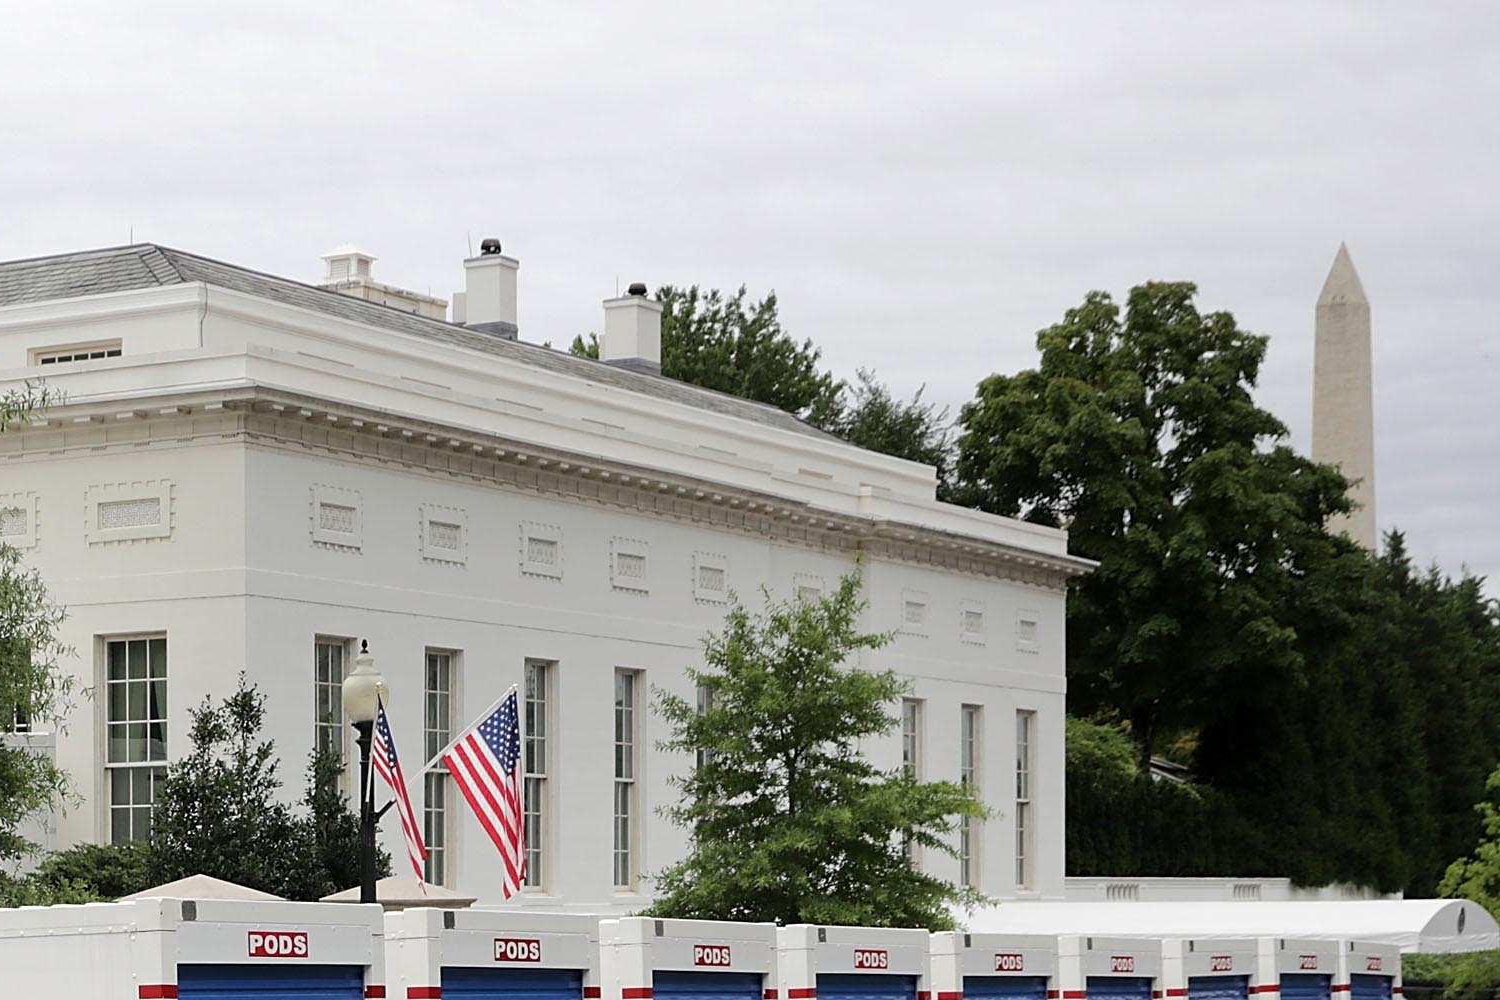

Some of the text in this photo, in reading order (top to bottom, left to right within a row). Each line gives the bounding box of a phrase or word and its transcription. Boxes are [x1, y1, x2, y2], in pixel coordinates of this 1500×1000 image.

[249, 934, 307, 955] PODS
[495, 941, 540, 960] PODS
[694, 947, 730, 965] PODS
[855, 951, 888, 967] PODS
[995, 955, 1022, 970] PODS
[1111, 957, 1134, 971] PODS
